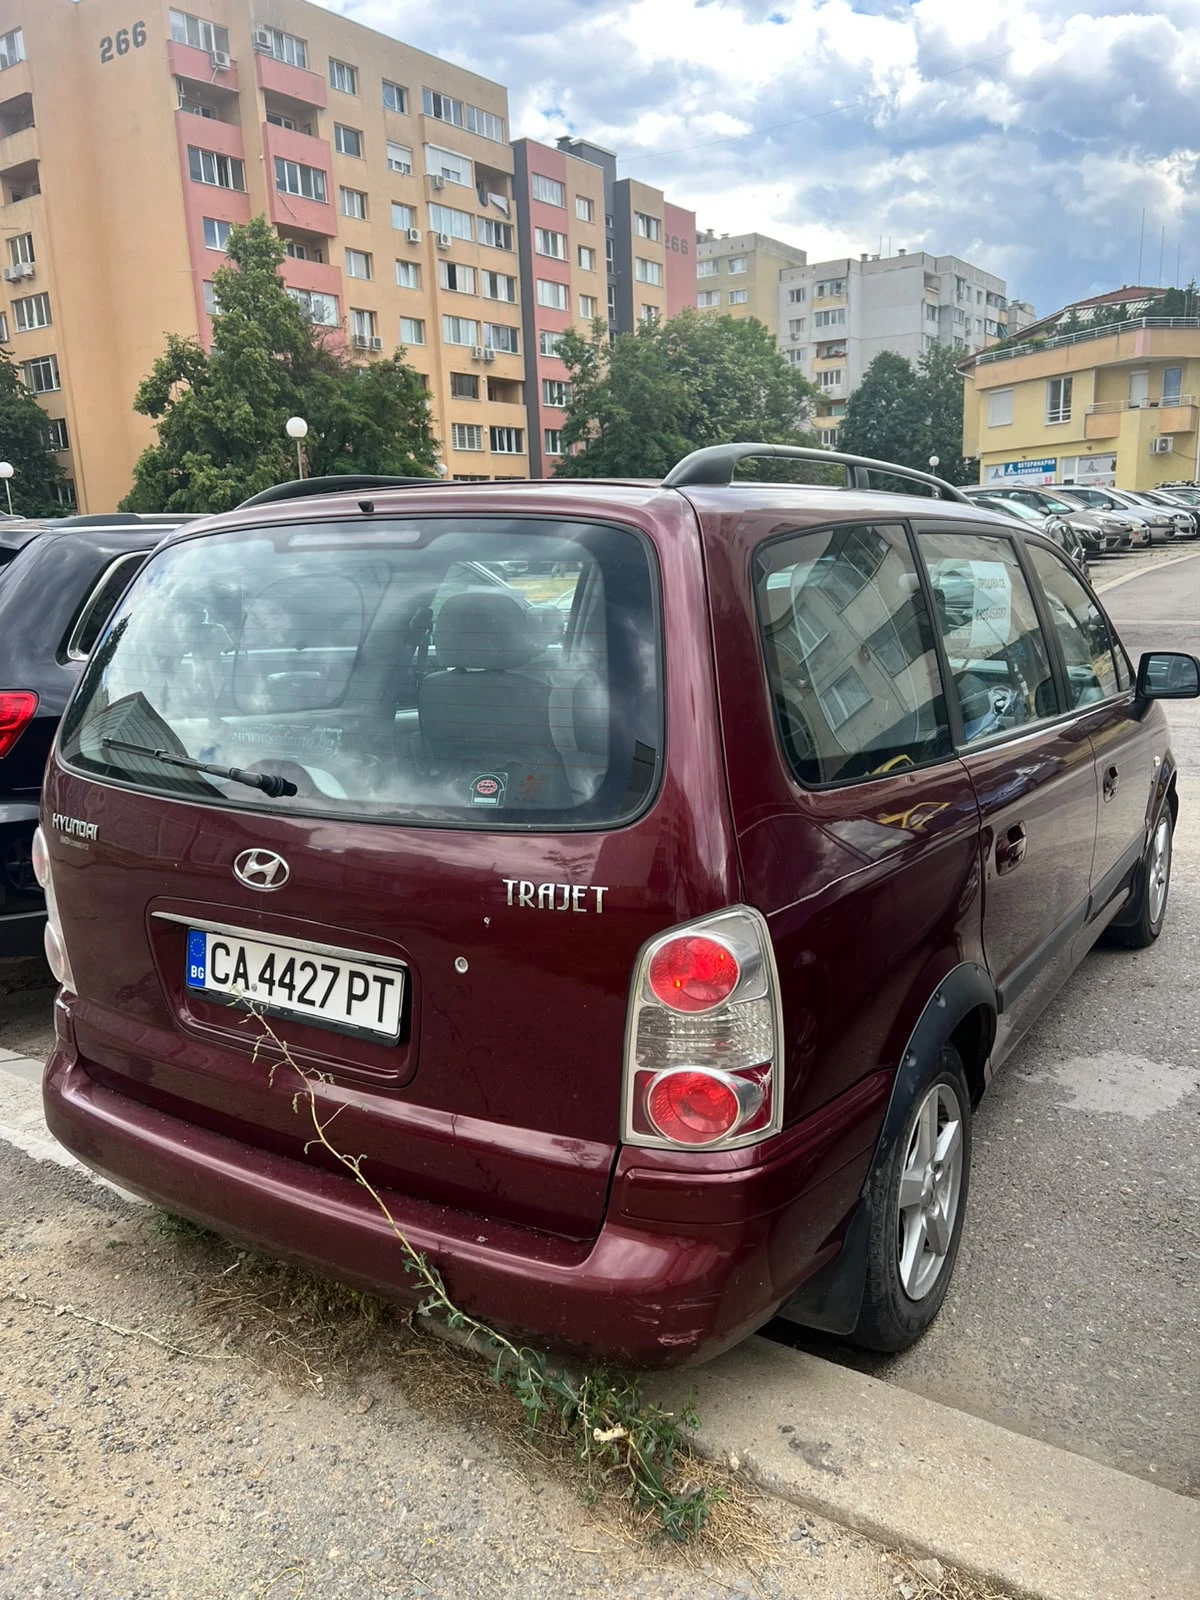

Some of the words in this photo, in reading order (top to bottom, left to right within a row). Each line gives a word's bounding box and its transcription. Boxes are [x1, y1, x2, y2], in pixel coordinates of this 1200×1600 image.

[100, 20, 147, 64] 266
[1017, 458, 1056, 469] ВЕТЕРИНАРНА
[52, 812, 99, 841] HYUNDAI
[502, 879, 609, 914] TRAJET
[191, 965, 205, 979] BG
[210, 942, 250, 991] CA
[258, 952, 340, 1009] 4427
[345, 969, 395, 1023] PT
